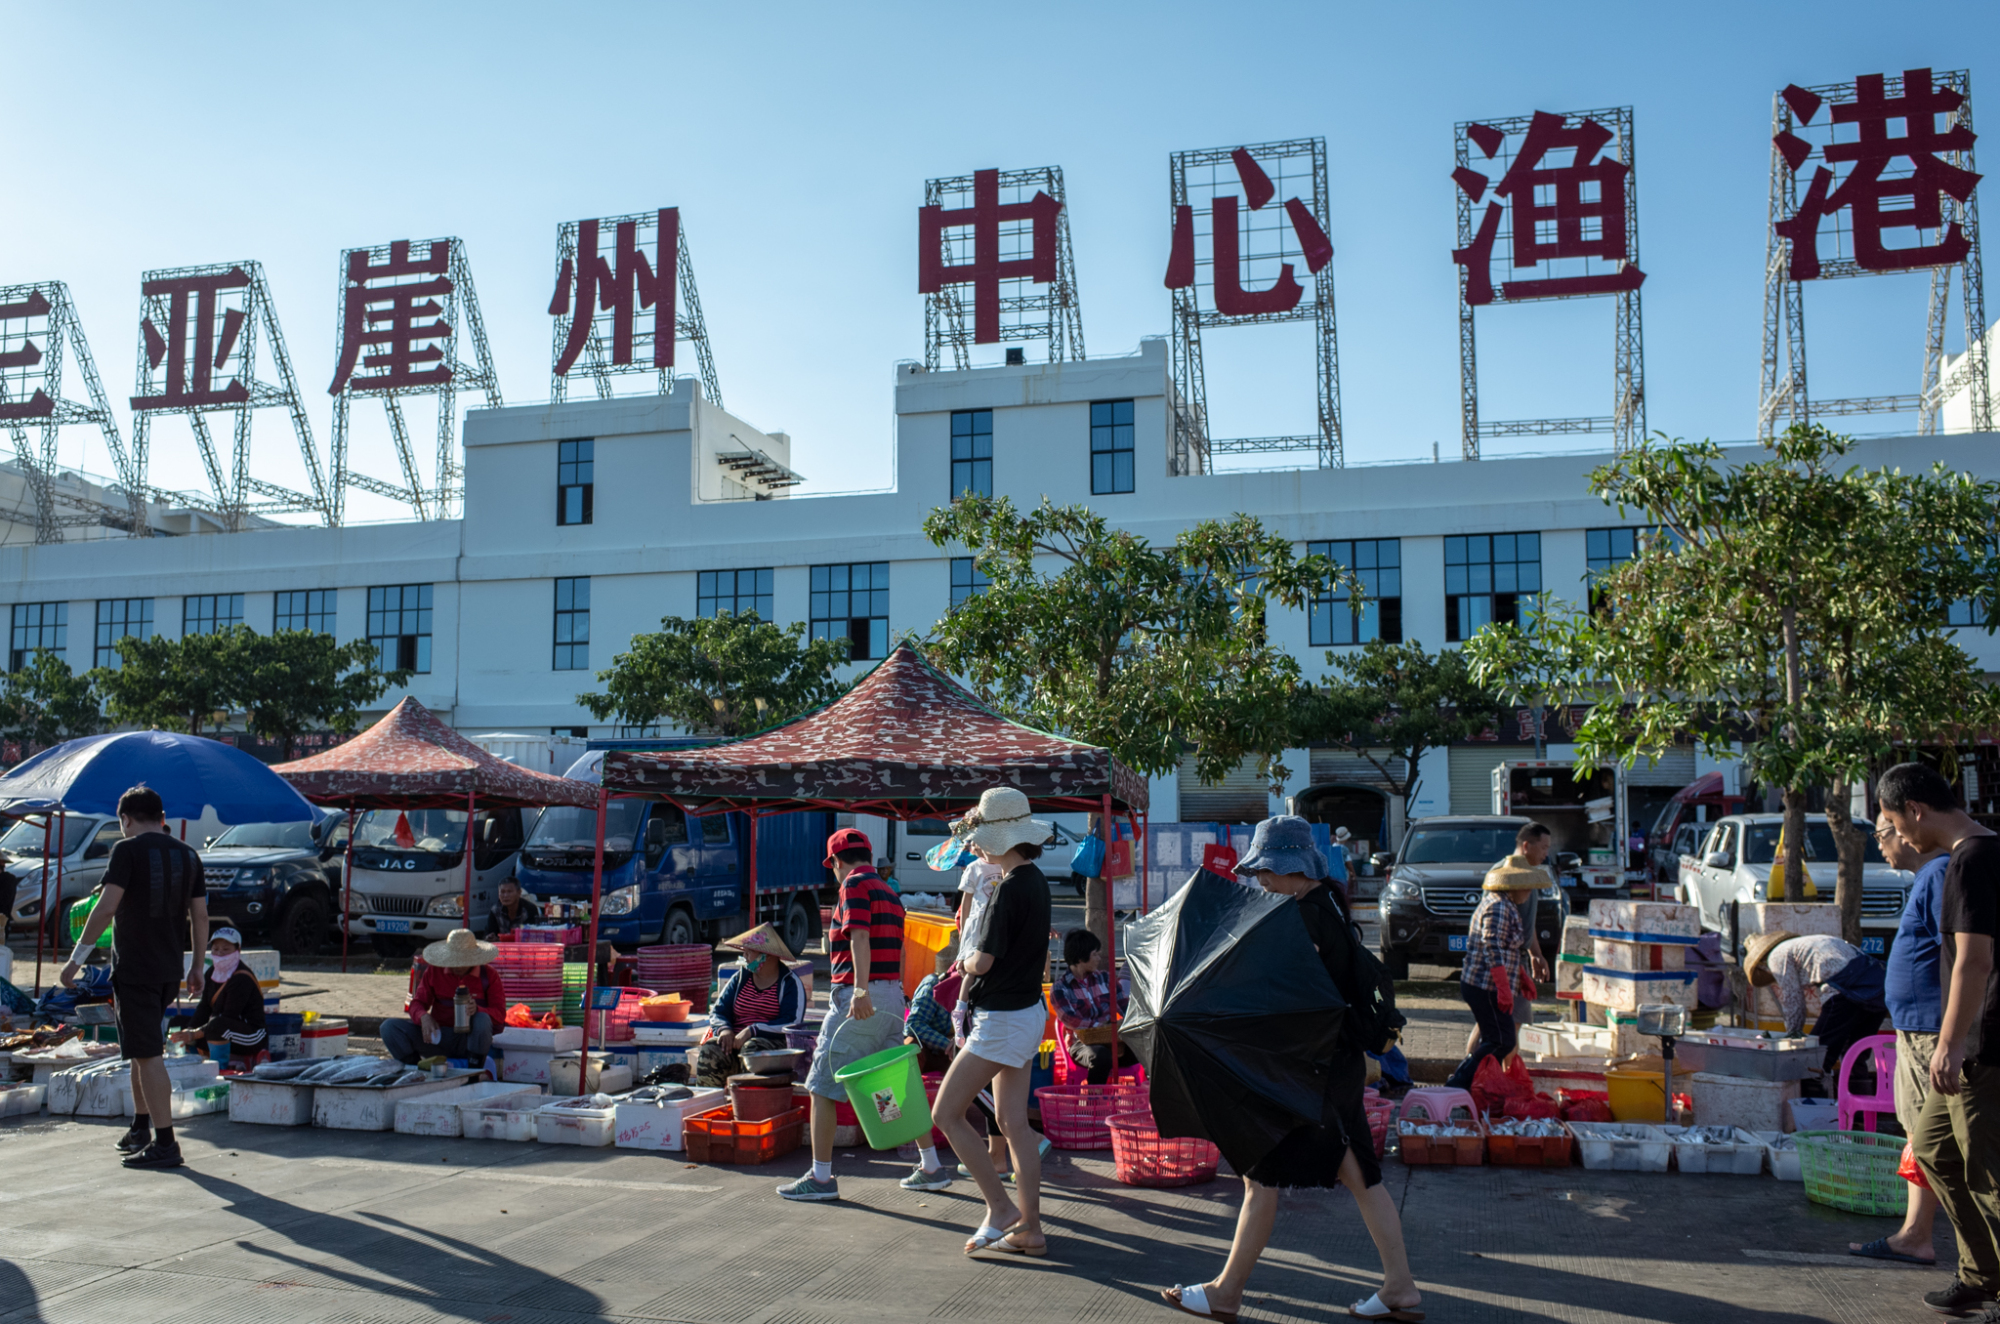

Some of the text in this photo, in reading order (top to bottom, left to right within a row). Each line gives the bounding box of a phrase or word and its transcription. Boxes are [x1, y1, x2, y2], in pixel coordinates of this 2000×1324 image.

[379, 858, 416, 870] JAC
[534, 857, 605, 867] FORLAN
[1862, 937, 1883, 952] 272
